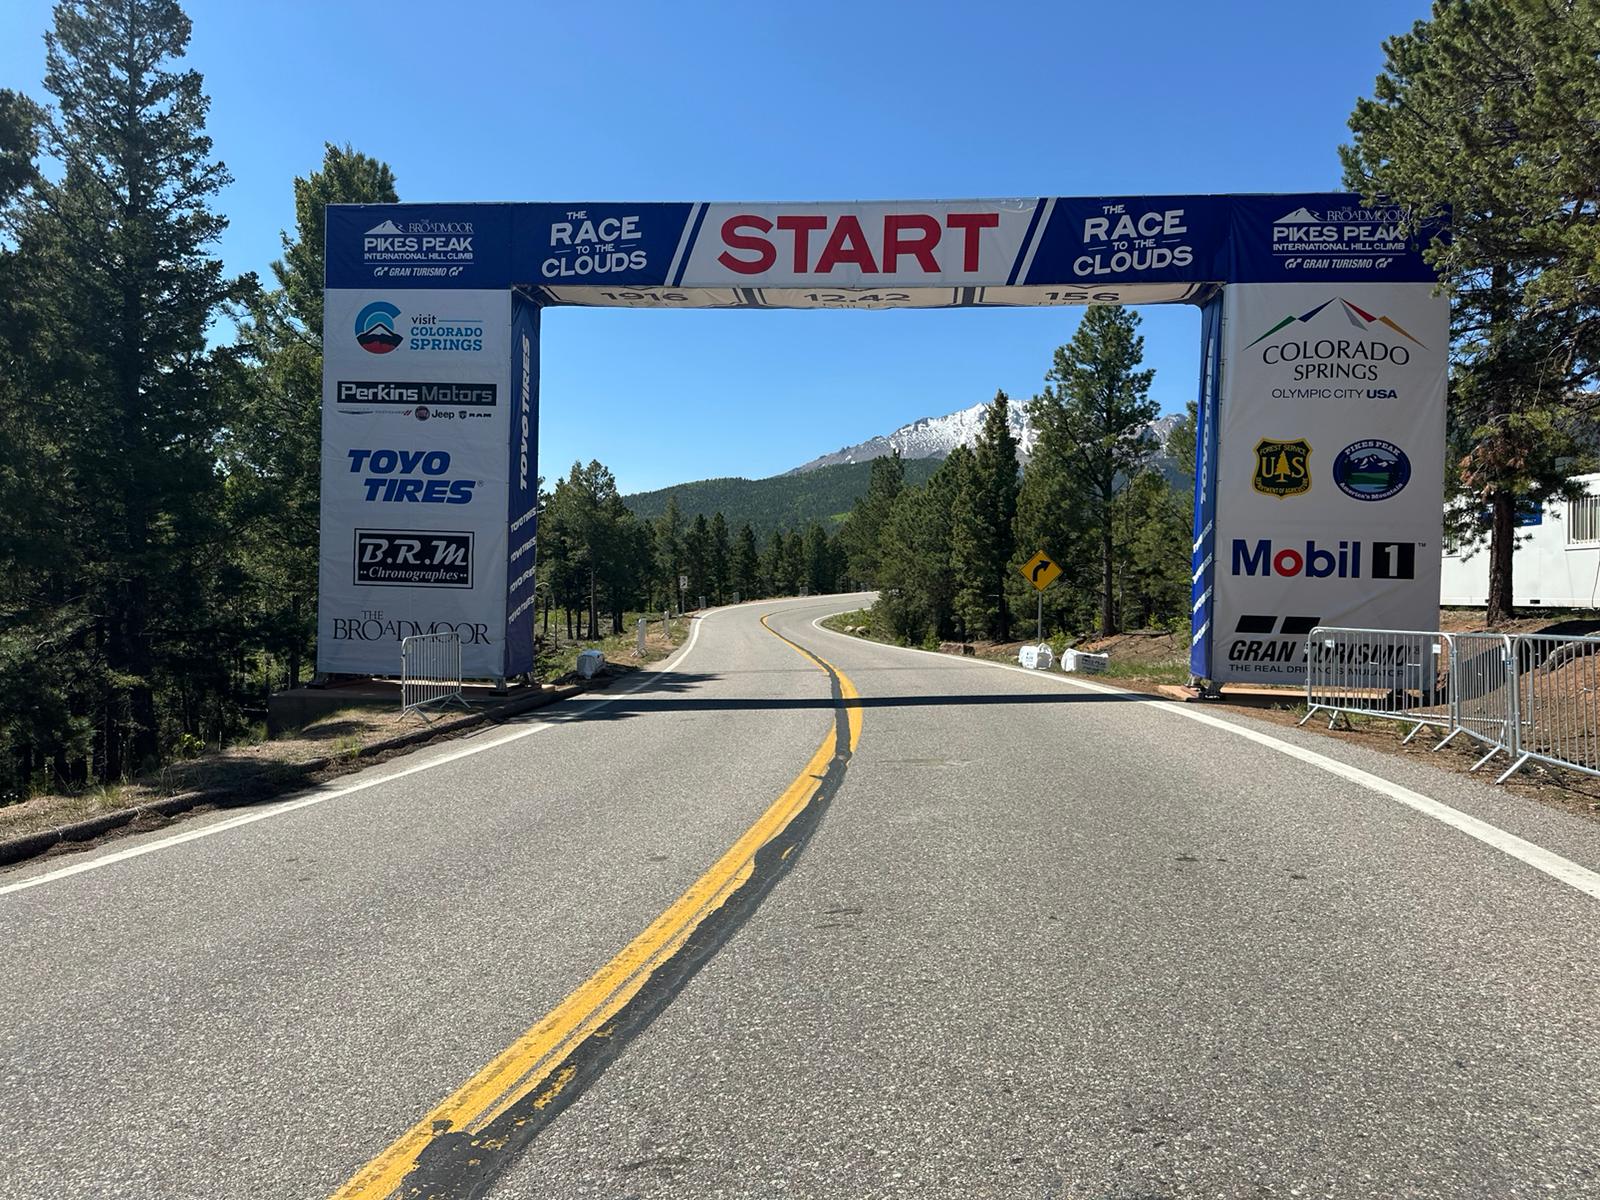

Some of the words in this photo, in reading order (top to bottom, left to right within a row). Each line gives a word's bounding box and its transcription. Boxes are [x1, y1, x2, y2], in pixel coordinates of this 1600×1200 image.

[566, 211, 587, 220] THE
[1102, 204, 1125, 214] THE
[409, 222, 473, 233] BROADMOOR
[550, 216, 642, 246] RACE
[1083, 209, 1187, 243] RACE
[1273, 226, 1338, 242] PIKES
[364, 238, 418, 251] PIKES
[423, 238, 473, 251] PEAK
[576, 245, 590, 254] TO
[595, 243, 615, 252] THE
[717, 213, 999, 274] START
[1112, 241, 1128, 250] TO
[1133, 239, 1156, 248] THE
[541, 250, 647, 278] CLOUDS
[1073, 246, 1193, 276] CLOUDS
[1303, 259, 1329, 268] GRAN
[1332, 259, 1372, 268] TURISMO
[389, 267, 410, 276] GRAN
[412, 267, 447, 276] TURISMO
[601, 292, 688, 301] 1916
[804, 293, 910, 302] 12.42
[1045, 292, 1119, 301] 156
[411, 314, 437, 325] visit
[410, 327, 483, 337] COLORADO
[410, 338, 483, 351] SPRINGS
[1262, 340, 1410, 366] COLORADO
[522, 334, 530, 412] TIRES
[1293, 363, 1378, 381] SPRINGS
[341, 383, 419, 400] Perkins
[421, 385, 493, 402] Motors
[1271, 388, 1331, 399] OLYMPIC
[1333, 389, 1364, 399] CITY
[1366, 389, 1398, 399] USA
[432, 409, 455, 420] Jeep
[520, 415, 529, 490] TOYO
[1260, 444, 1281, 456] FOREST
[1345, 441, 1374, 456] PIKES
[1375, 441, 1400, 456] PEAK
[347, 449, 451, 475] TOYO
[363, 478, 476, 504] TIRES
[1339, 482, 1371, 500] America's
[1371, 482, 1403, 500] Mountain
[360, 538, 468, 566] B.R.M
[1231, 539, 1361, 578] Mobil
[369, 566, 459, 582] Chronographes
[361, 610, 384, 620] THE
[333, 617, 491, 645] BROADMOOR
[1228, 639, 1297, 662] GRAN
[1229, 664, 1251, 672] THE
[1254, 664, 1283, 673] REAL
[1336, 667, 1404, 677] SMULATOR
